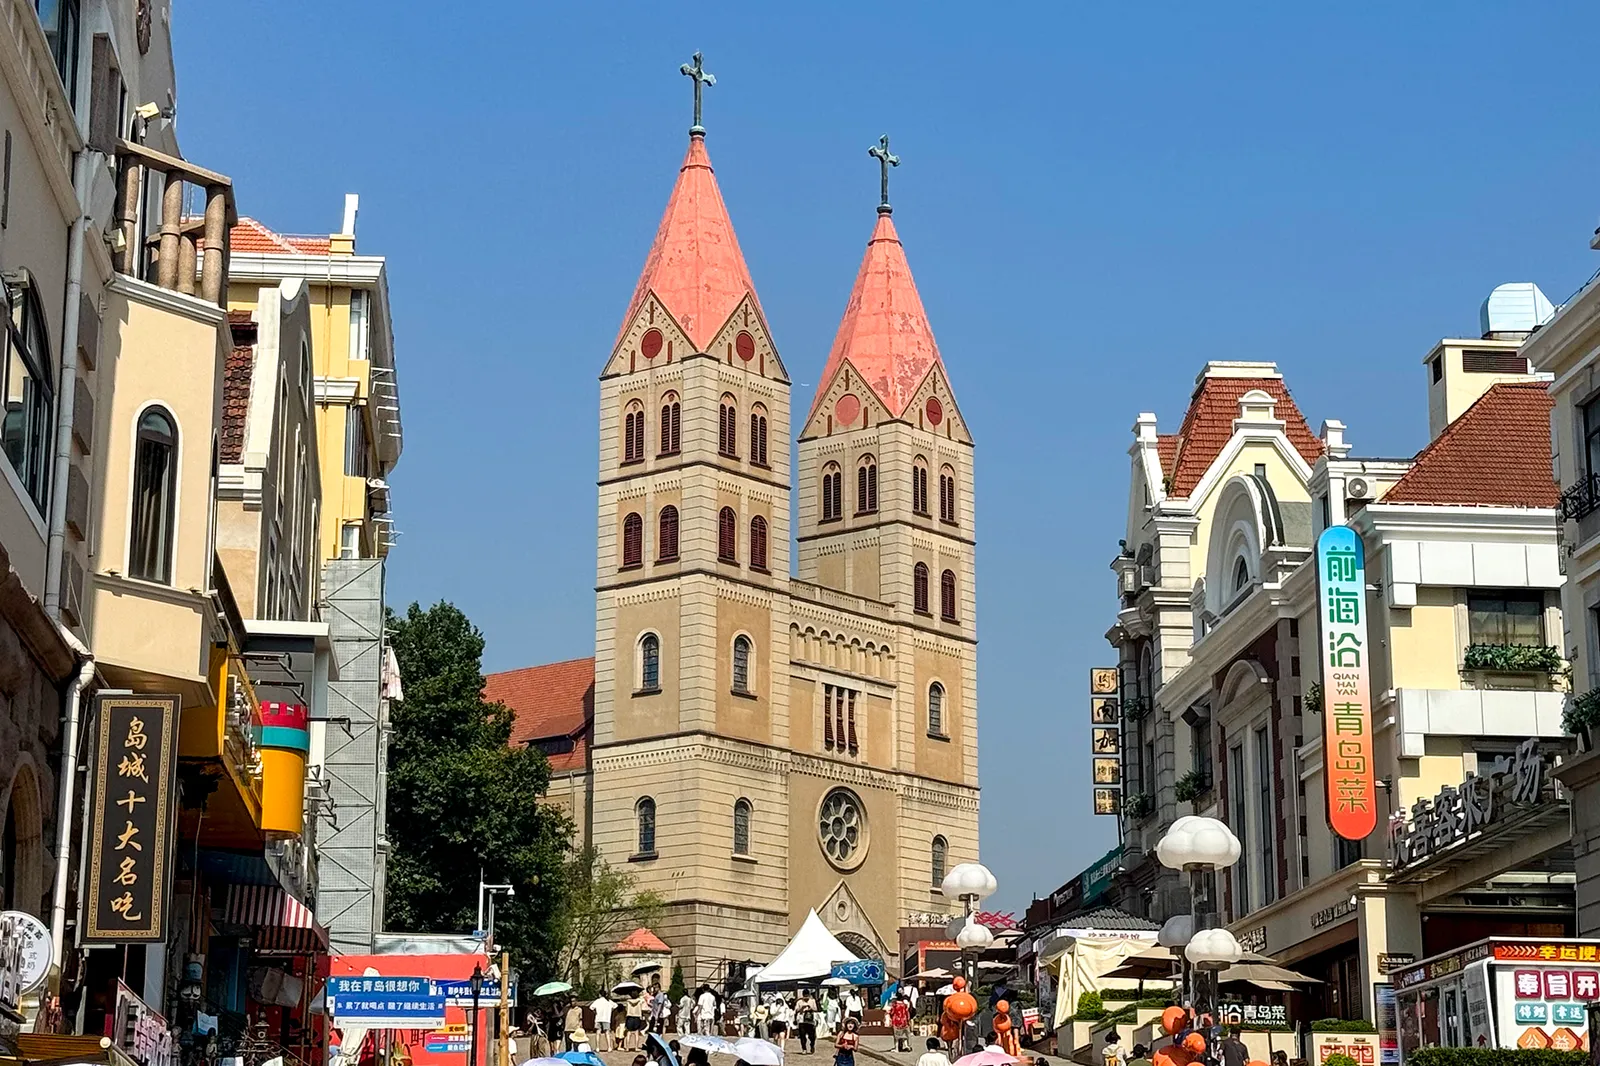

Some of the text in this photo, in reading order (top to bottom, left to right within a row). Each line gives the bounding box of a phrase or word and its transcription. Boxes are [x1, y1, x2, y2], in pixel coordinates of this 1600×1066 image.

[1326, 545, 1362, 668] 前海沿
[1333, 701, 1367, 813] 青岛菜
[110, 716, 149, 921] 岛城十大名吃
[1539, 945, 1600, 960] 幸运便
[339, 980, 420, 993] 我在青岛很想你
[345, 1001, 385, 1010] 累了就喝点
[1243, 1005, 1286, 1020] 青岛菜
